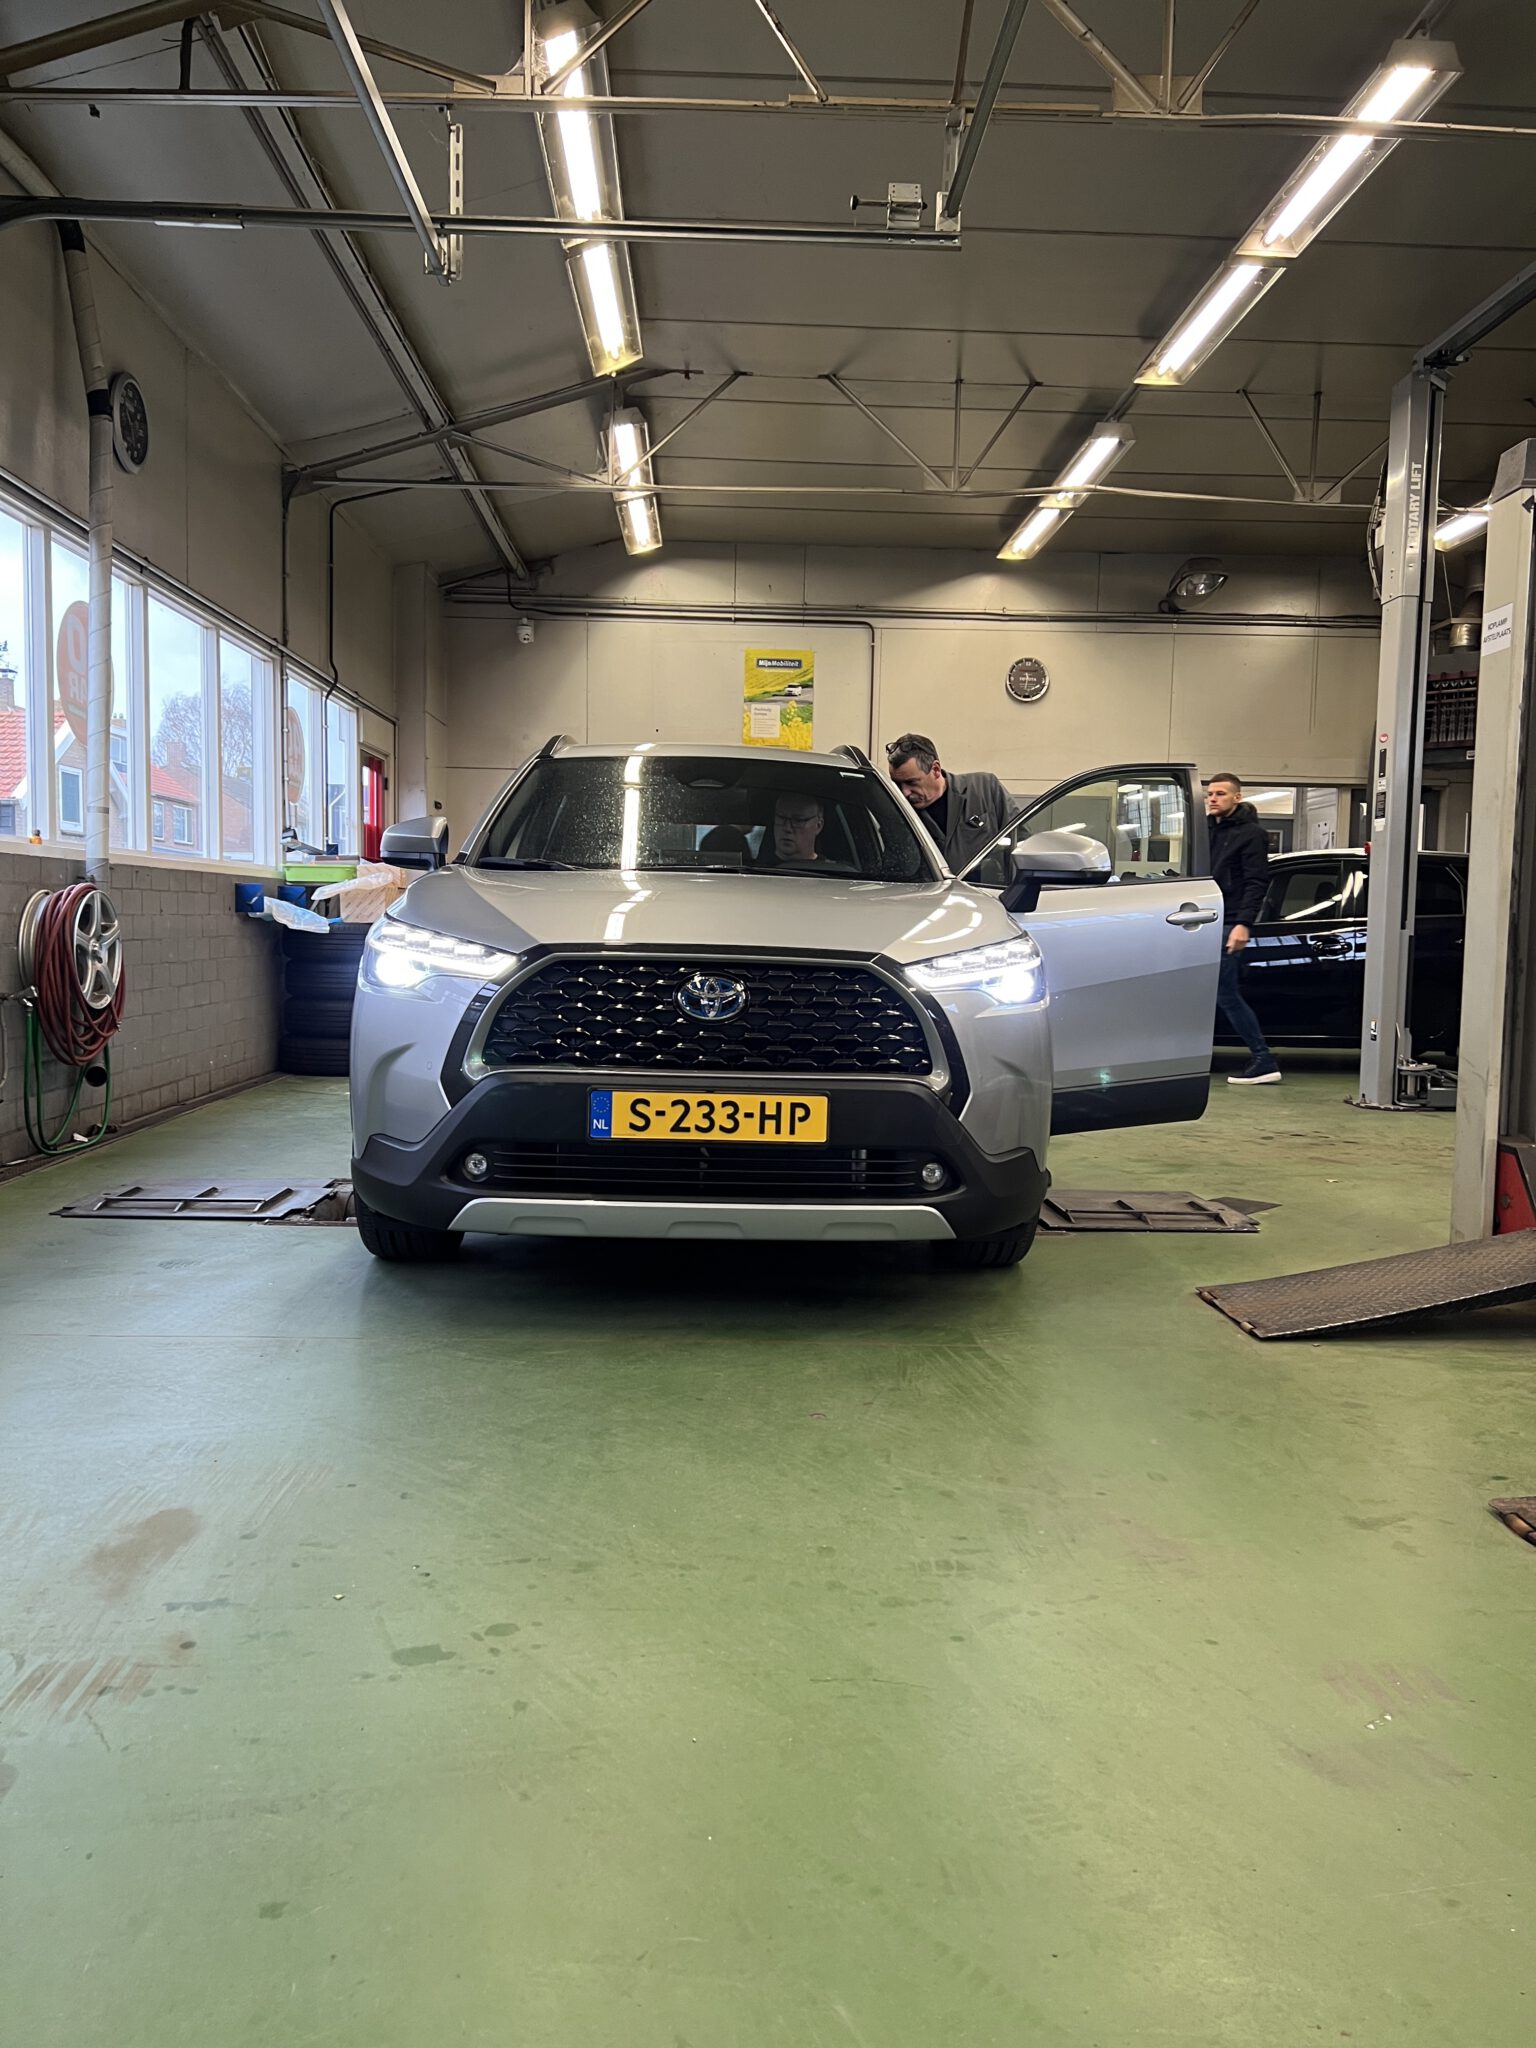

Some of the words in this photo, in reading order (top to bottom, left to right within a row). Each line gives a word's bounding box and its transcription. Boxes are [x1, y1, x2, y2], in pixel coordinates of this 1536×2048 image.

[1410, 462, 1423, 490] LIFT
[592, 1118, 609, 1130] NL
[628, 1097, 812, 1136] S-233-HP
